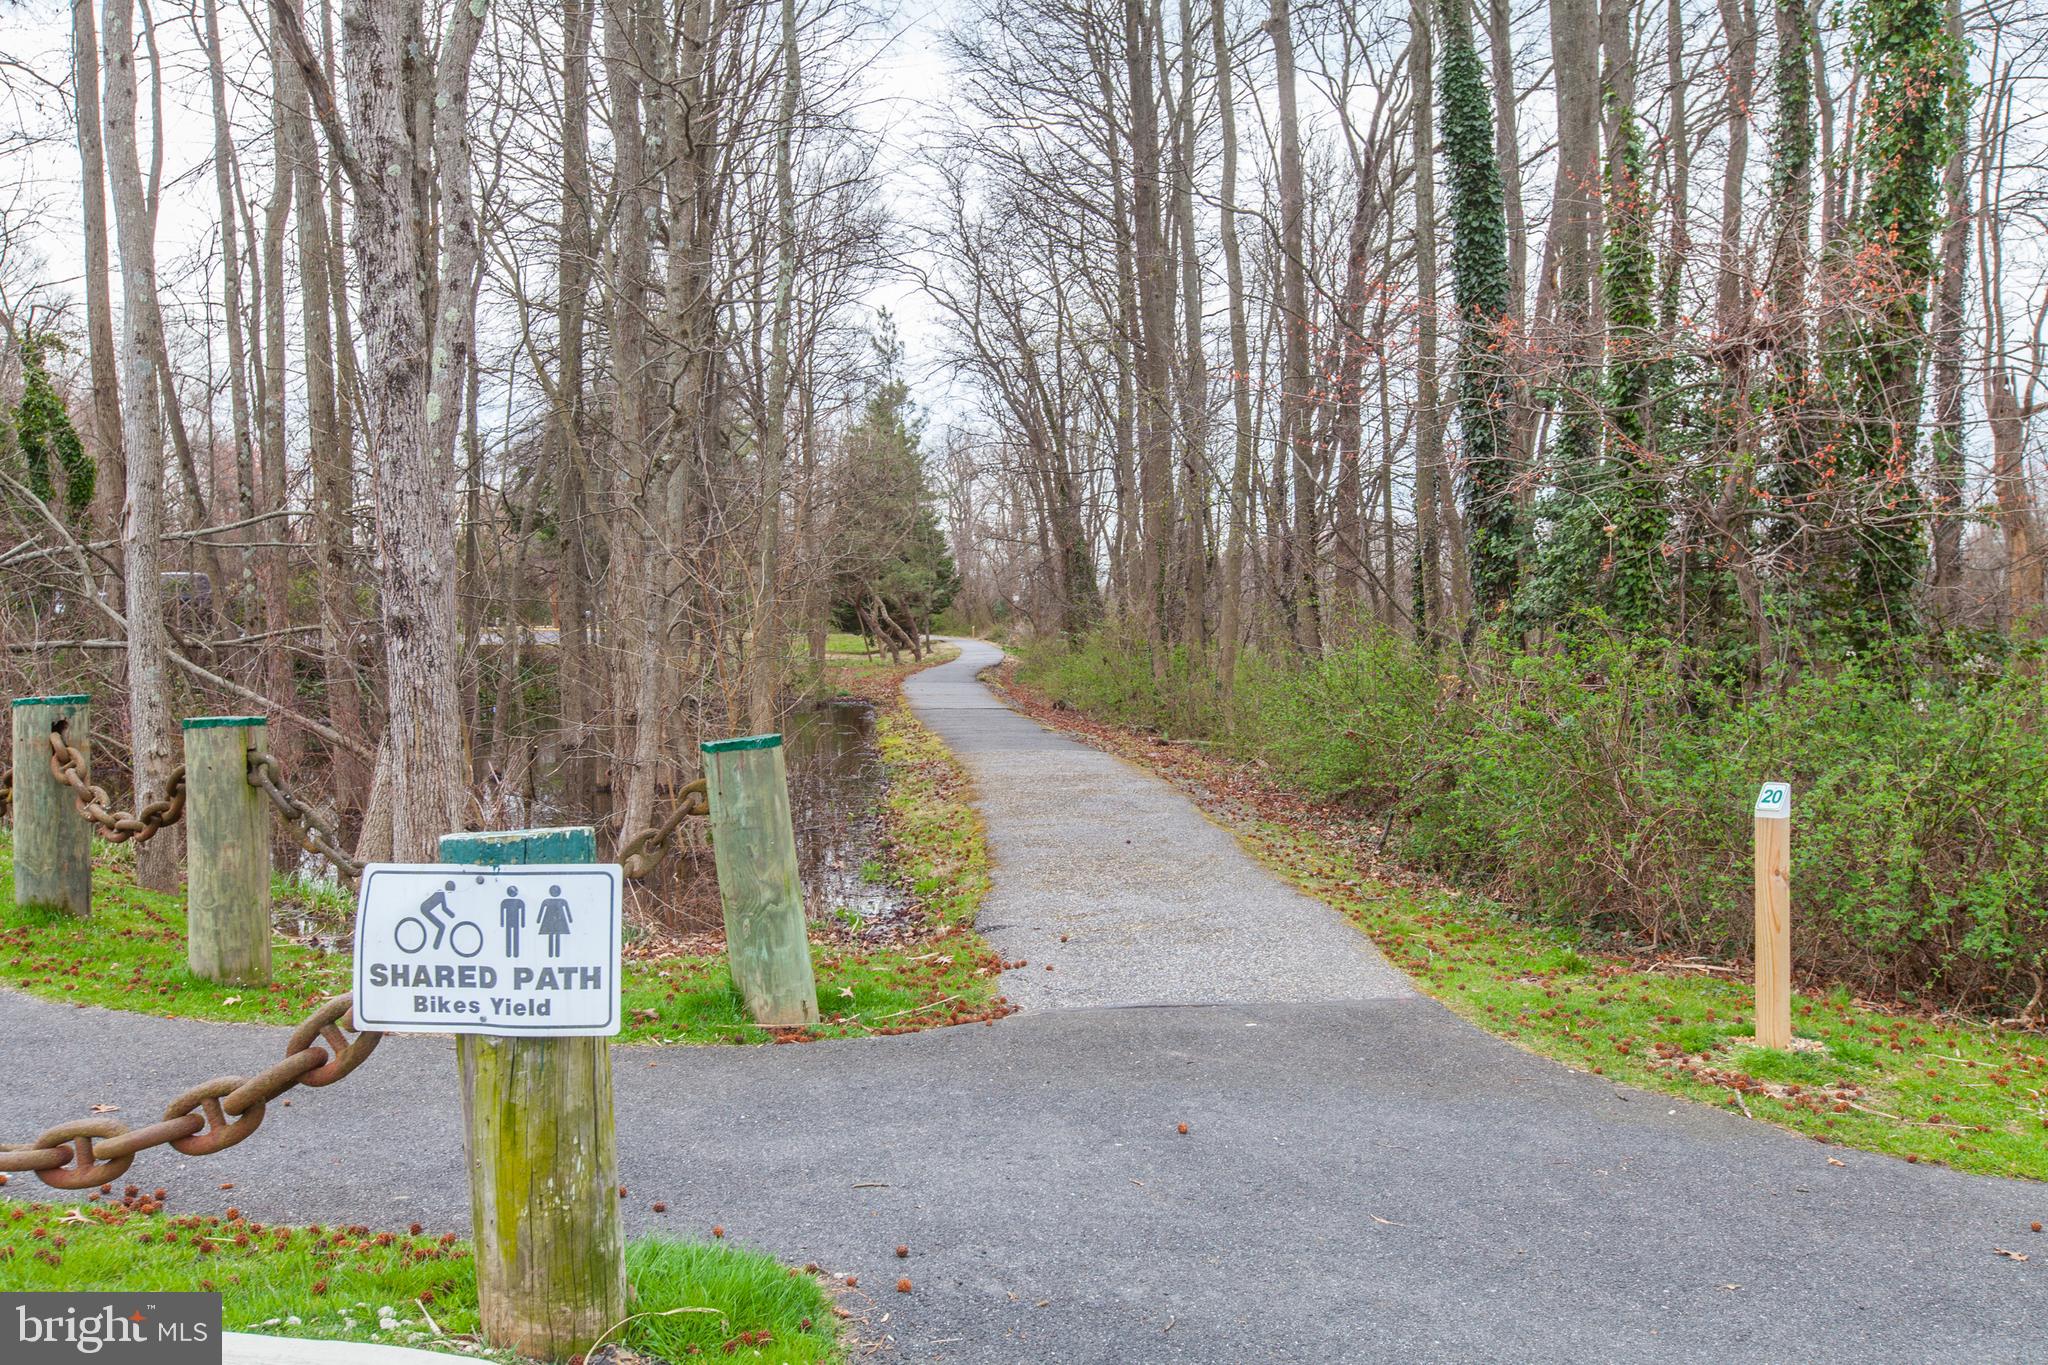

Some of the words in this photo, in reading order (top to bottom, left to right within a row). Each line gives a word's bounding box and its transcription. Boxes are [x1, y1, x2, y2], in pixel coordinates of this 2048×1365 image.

[1761, 789, 1783, 803] 20
[370, 963, 497, 989] SHARED
[514, 966, 601, 990] PATH
[414, 996, 480, 1014] Bikes
[490, 998, 551, 1016] Yield
